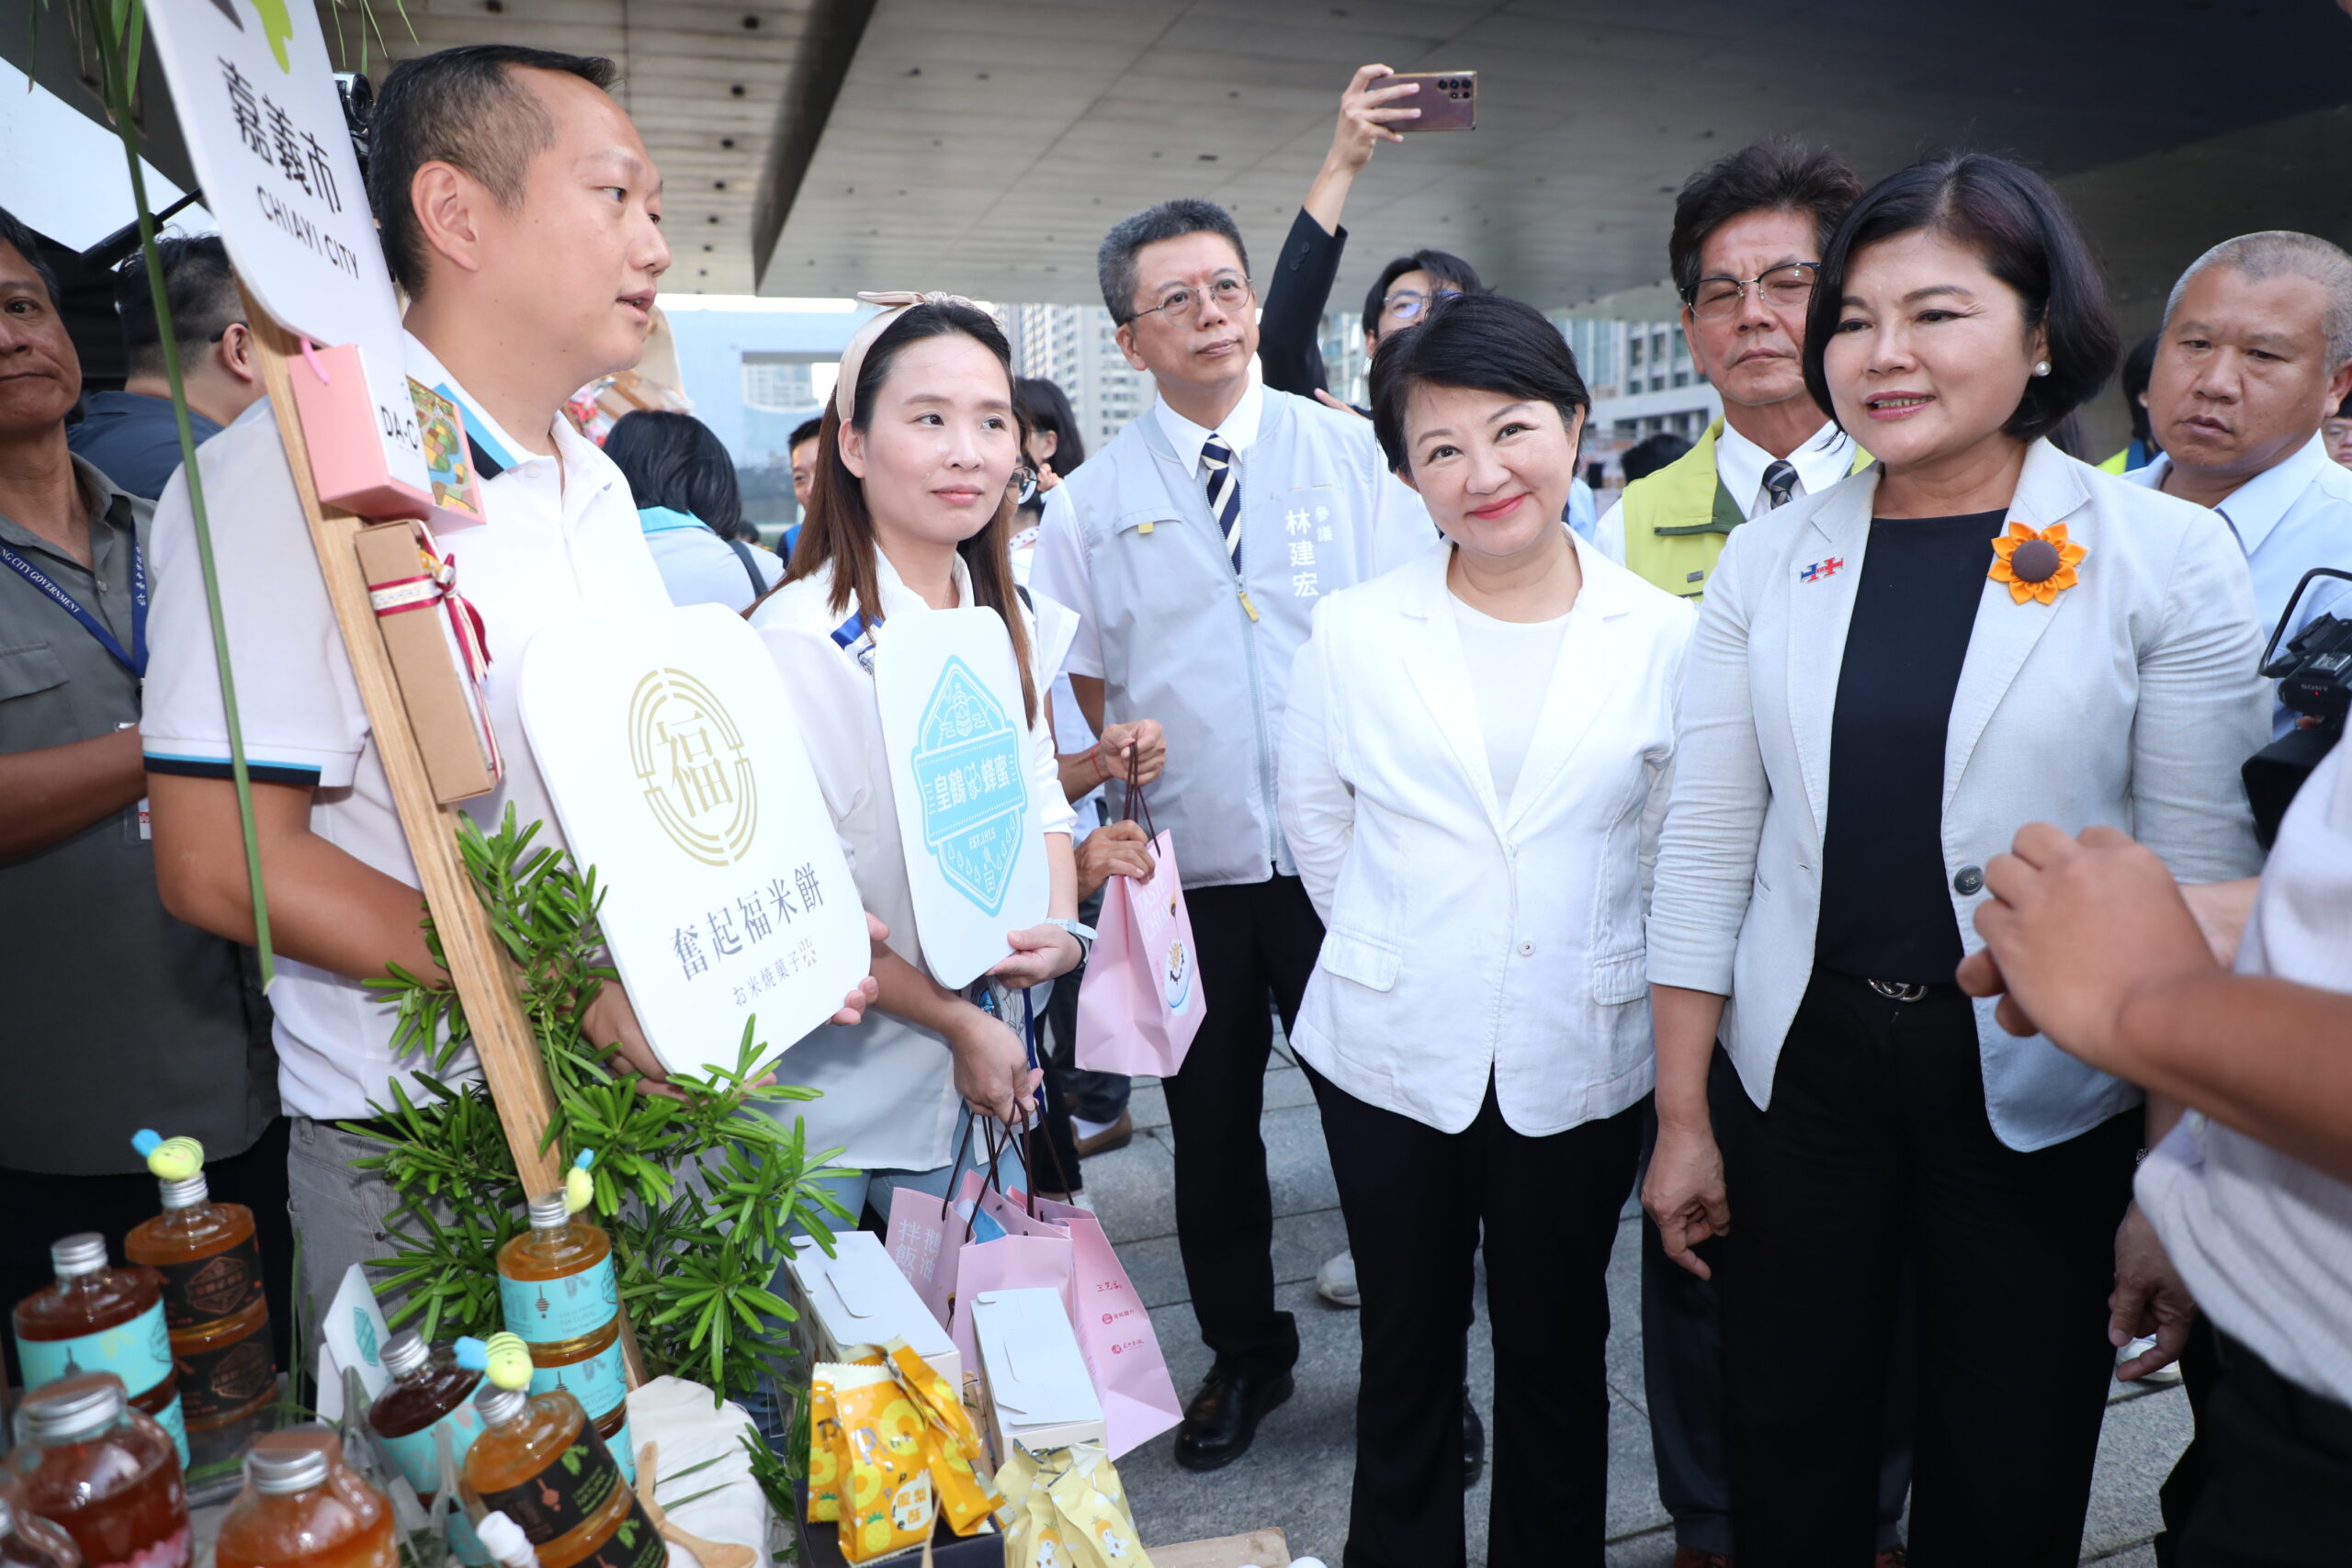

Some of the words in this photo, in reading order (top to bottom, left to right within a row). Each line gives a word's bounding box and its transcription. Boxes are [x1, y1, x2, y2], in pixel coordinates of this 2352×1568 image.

[218, 56, 343, 215] 嘉義市
[256, 186, 322, 256] CHIAYI
[324, 236, 361, 280] CITY
[11, 558, 33, 574] CITY
[29, 571, 82, 614] GOVERNMENT
[1284, 508, 1319, 597] 林建宏
[655, 710, 734, 818] 福
[670, 863, 824, 981] 奮起福米餅
